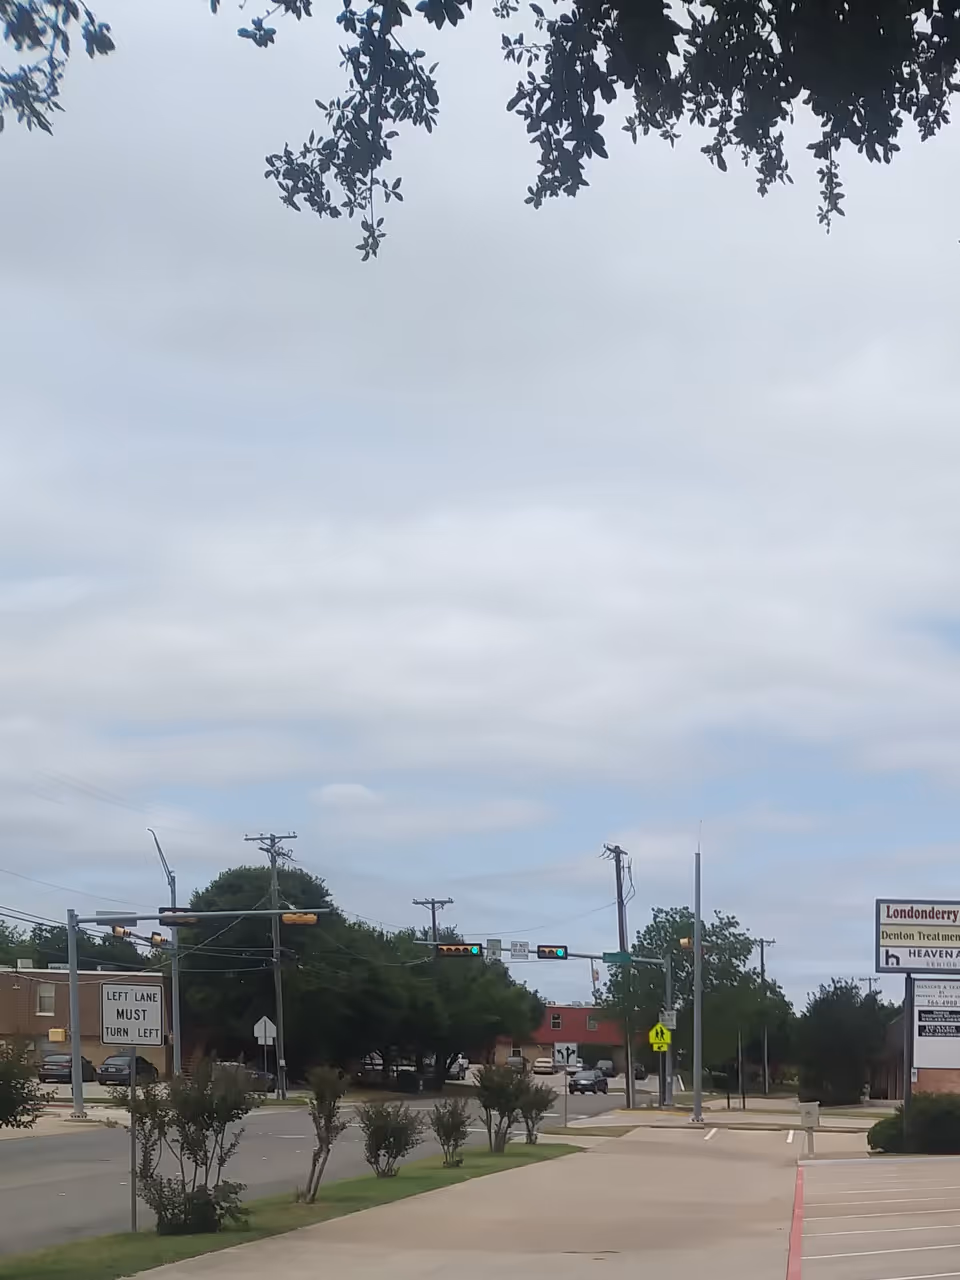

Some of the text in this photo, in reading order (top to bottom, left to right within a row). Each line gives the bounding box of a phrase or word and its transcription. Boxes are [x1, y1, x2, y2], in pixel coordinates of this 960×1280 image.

[886, 905, 960, 923] Londonderry
[881, 930, 915, 940] Denton
[908, 949, 953, 959] HEAVEN
[107, 991, 158, 1002] LEFT LANE
[116, 1008, 147, 1021] MUST
[105, 1027, 160, 1038] TURN LEFT
